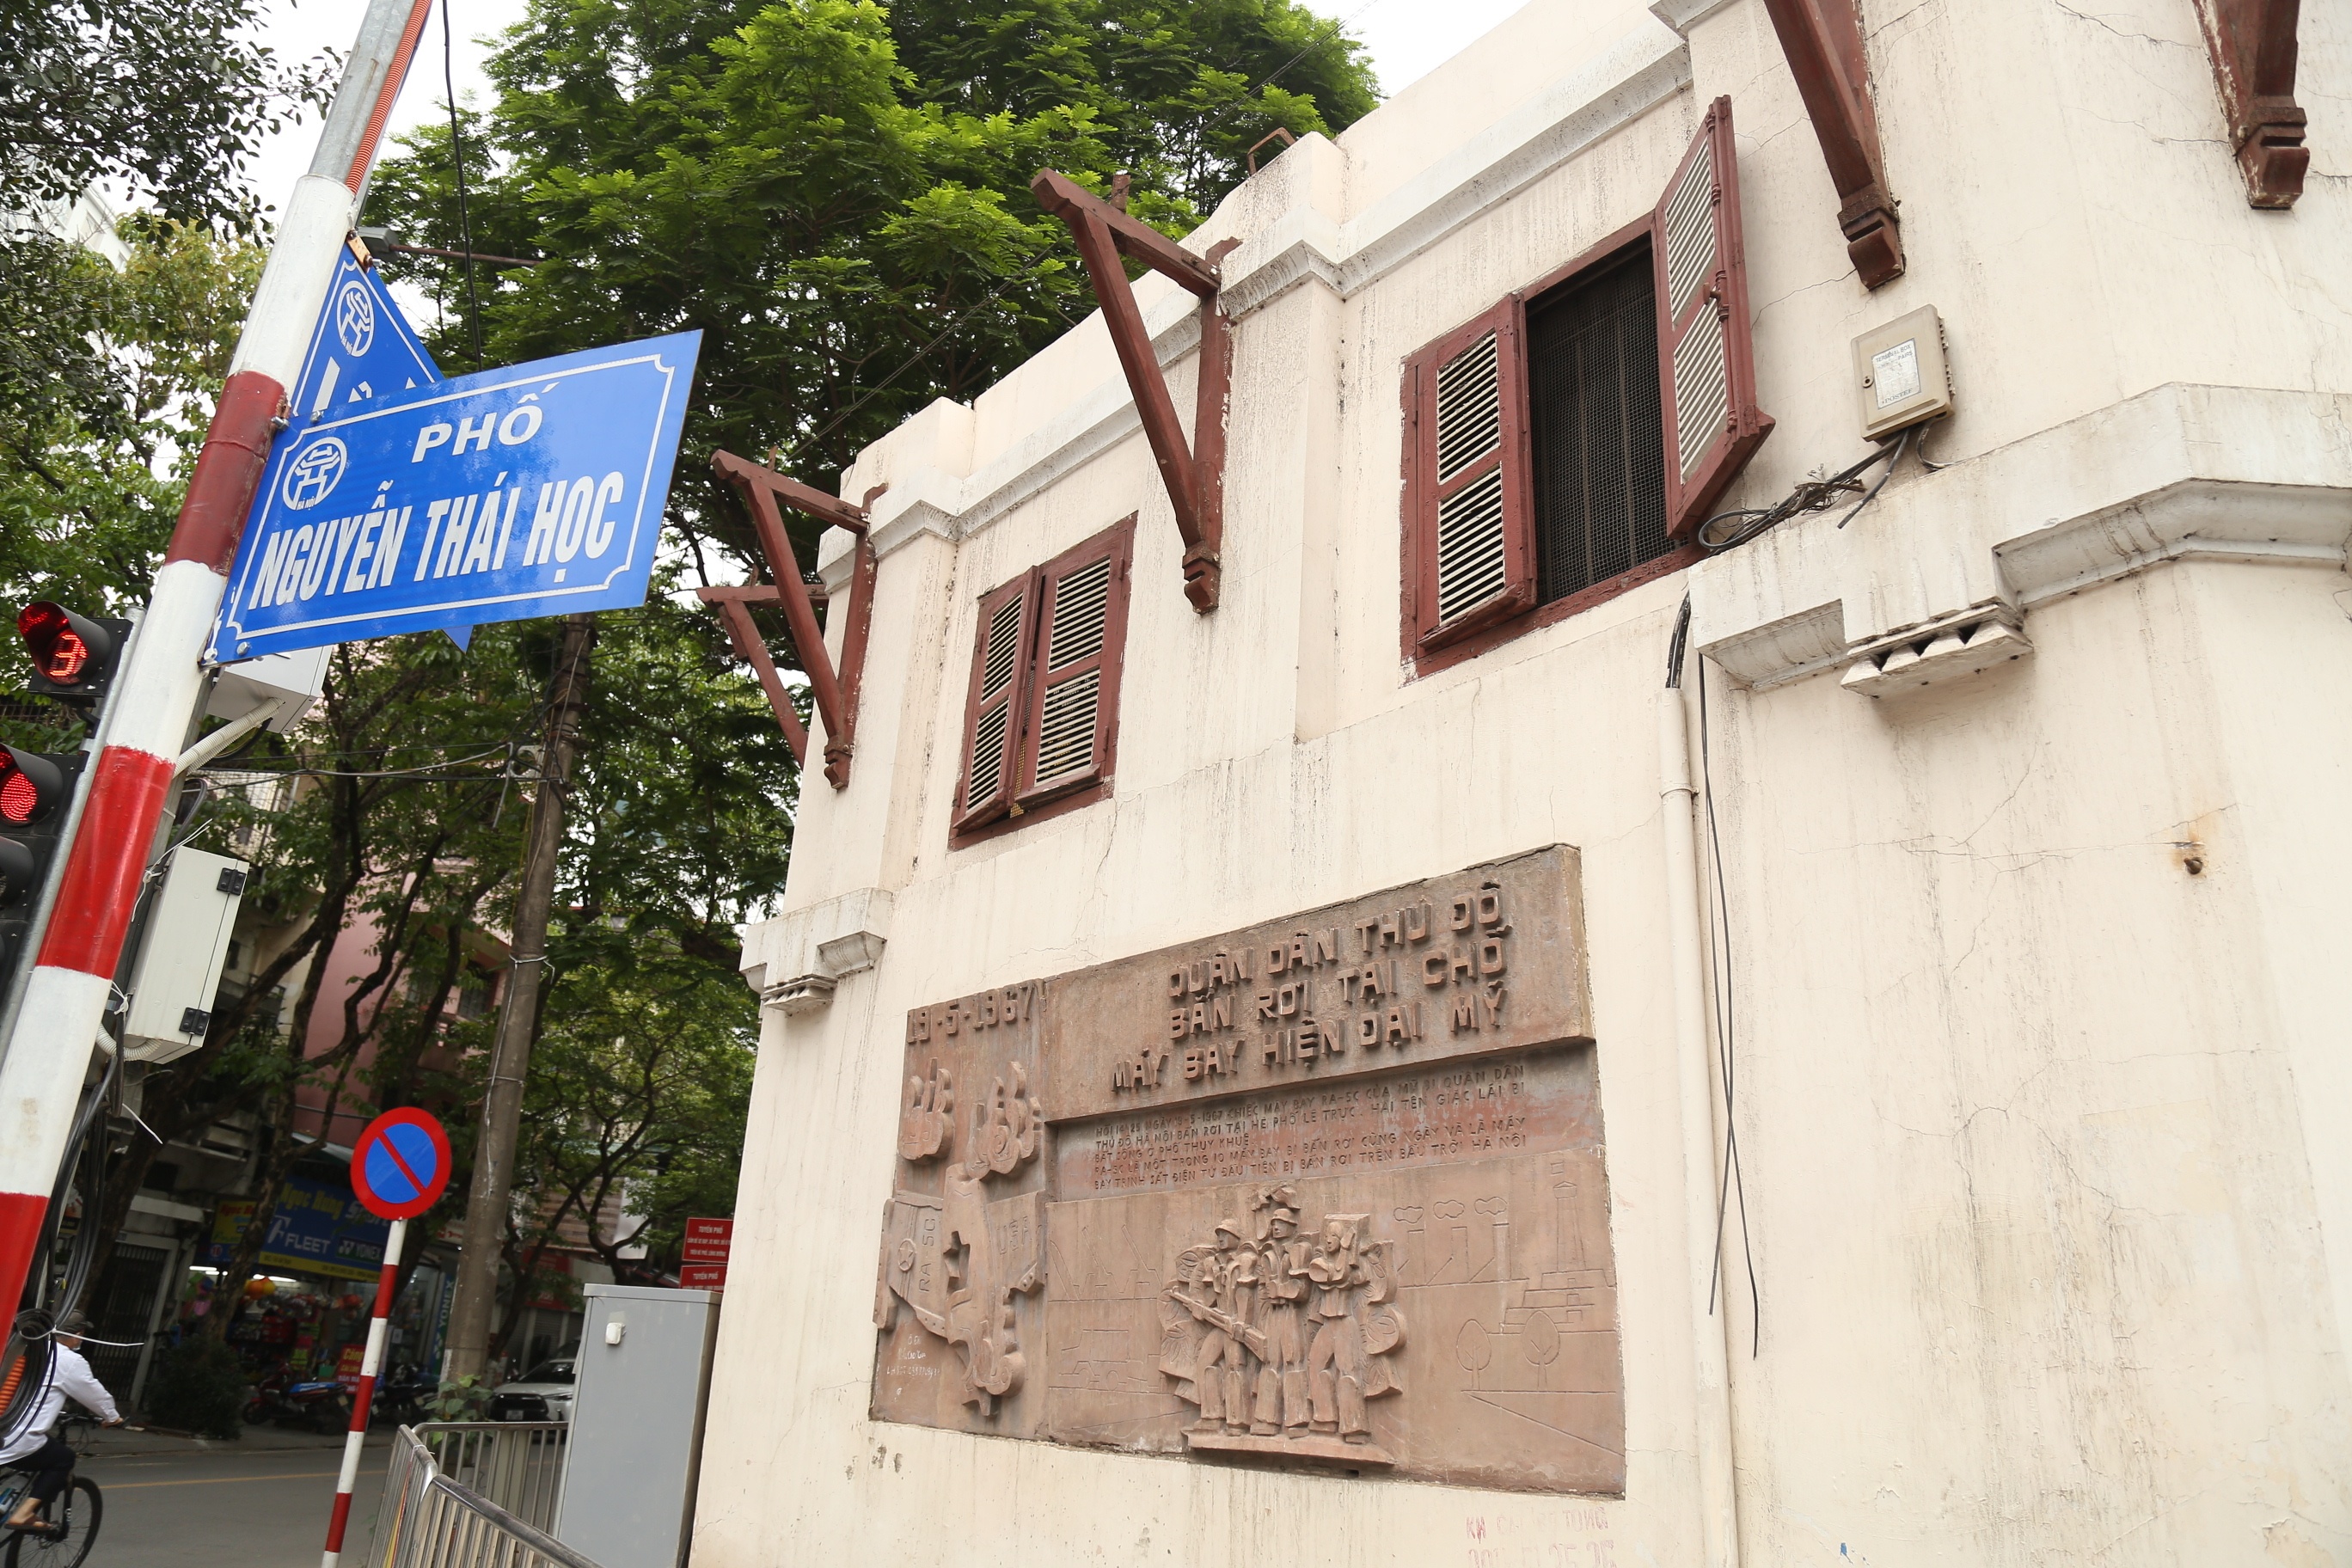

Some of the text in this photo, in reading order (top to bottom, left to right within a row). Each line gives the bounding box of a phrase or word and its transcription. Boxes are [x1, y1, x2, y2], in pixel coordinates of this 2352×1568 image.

[1897, 350, 1914, 360] PAIRS
[1900, 344, 1911, 352] BOX
[412, 382, 560, 462] PHỐ
[1884, 388, 1913, 403] POSTEF
[248, 471, 624, 610] NGUYỄN THÁI HỌC
[1167, 881, 1501, 997] QUÂN DÂN THỦ ĐÔ
[1170, 924, 1512, 1039] BẮN RƠI TẠI CHỖ
[1112, 980, 1508, 1092] MÁY BAY HIỆN ĐẠI MỸ
[1096, 1135, 1115, 1149] THỦ
[1118, 1135, 1131, 1148] ĐÔ
[1136, 1133, 1150, 1146] HÀ
[1155, 1130, 1173, 1144] NỘI
[1204, 1124, 1222, 1137] RƠI
[1228, 1121, 1246, 1135] TẠI
[1273, 1112, 1299, 1128] PHỐ
[1371, 1101, 1394, 1113] HAI
[1401, 1095, 1427, 1111] TÊN
[1436, 1088, 1470, 1106] GIẶC
[1479, 1084, 1502, 1100] LÁI
[1130, 1122, 1141, 1133] 25
[1293, 1095, 1315, 1110] BAY
[1321, 1090, 1359, 1106] RA-5C
[1444, 1070, 1485, 1088] QUÂN
[1494, 1064, 1524, 1081] DÂN
[1095, 1164, 1124, 1176] RA-5C
[1172, 1154, 1209, 1167] TRONG
[1229, 1148, 1255, 1161] MÁY
[1260, 1146, 1279, 1159] BAY
[1334, 1137, 1355, 1149] RƠI
[1404, 1125, 1439, 1142] NGÀY
[1445, 1121, 1463, 1137] VÀ
[1469, 1118, 1486, 1135] LÀ
[1492, 1115, 1526, 1132] MÁY
[1095, 1179, 1112, 1190] BAY
[1150, 1171, 1168, 1185] SÁT
[1173, 1168, 1196, 1184] ĐIỆN
[1249, 1160, 1277, 1174] TIÊN
[1283, 1158, 1294, 1174] BỊ
[1330, 1153, 1351, 1167] RƠI
[1359, 1148, 1393, 1162] TRÊN
[1472, 1136, 1492, 1151] HÀ
[1160, 1141, 1181, 1155] PHỐ
[285, 1233, 331, 1254] FLEET
[438, 1279, 455, 1327] YONEX
